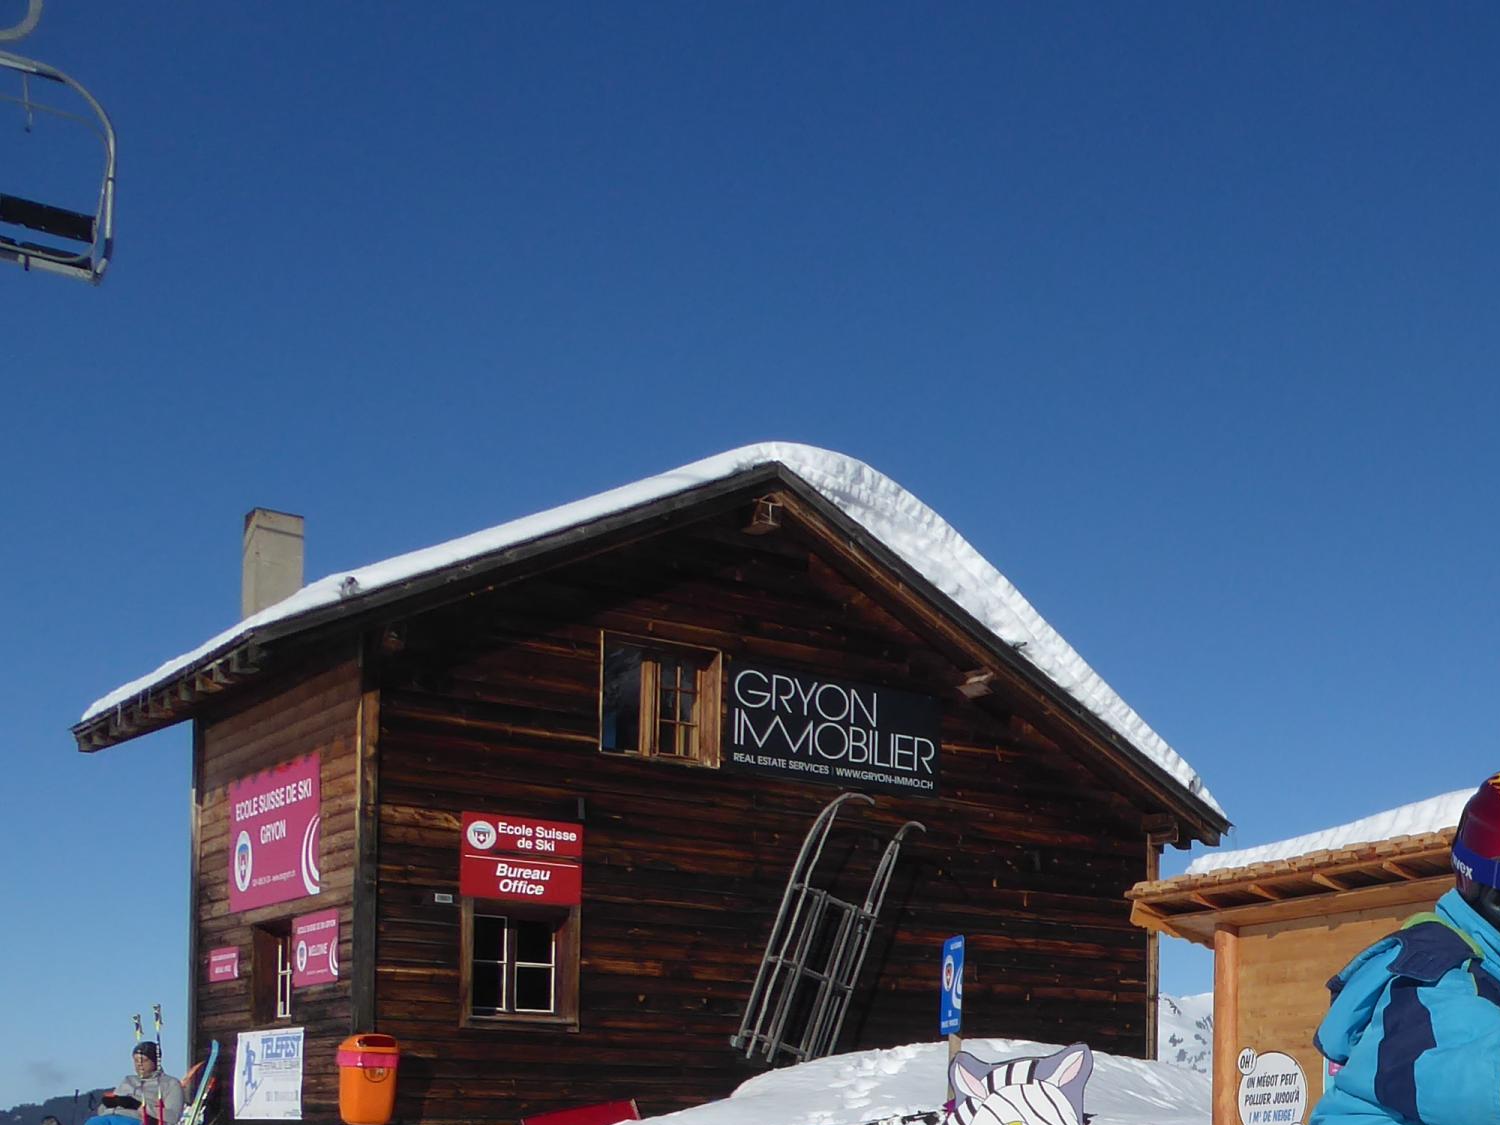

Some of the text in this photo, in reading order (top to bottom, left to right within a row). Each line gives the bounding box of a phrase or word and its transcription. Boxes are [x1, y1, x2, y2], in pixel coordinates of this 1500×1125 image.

[734, 669, 877, 728] GRYON
[733, 707, 935, 774] IMMOBILIER
[733, 752, 934, 790] REAL ESTATE SERVICES WWW.GRYON-IMMO.CH
[235, 777, 312, 822] ECOLE SUISSE DE SKI
[260, 818, 287, 845] GRYON
[498, 821, 577, 842] Ecole Suisse
[517, 837, 556, 852] de Ski
[495, 863, 551, 881] Bureau
[499, 879, 545, 896] Office
[1247, 1071, 1298, 1088] UN MÉGOT PEUT
[1245, 1093, 1271, 1106] POLLUER
[1262, 1110, 1272, 1123] DE
